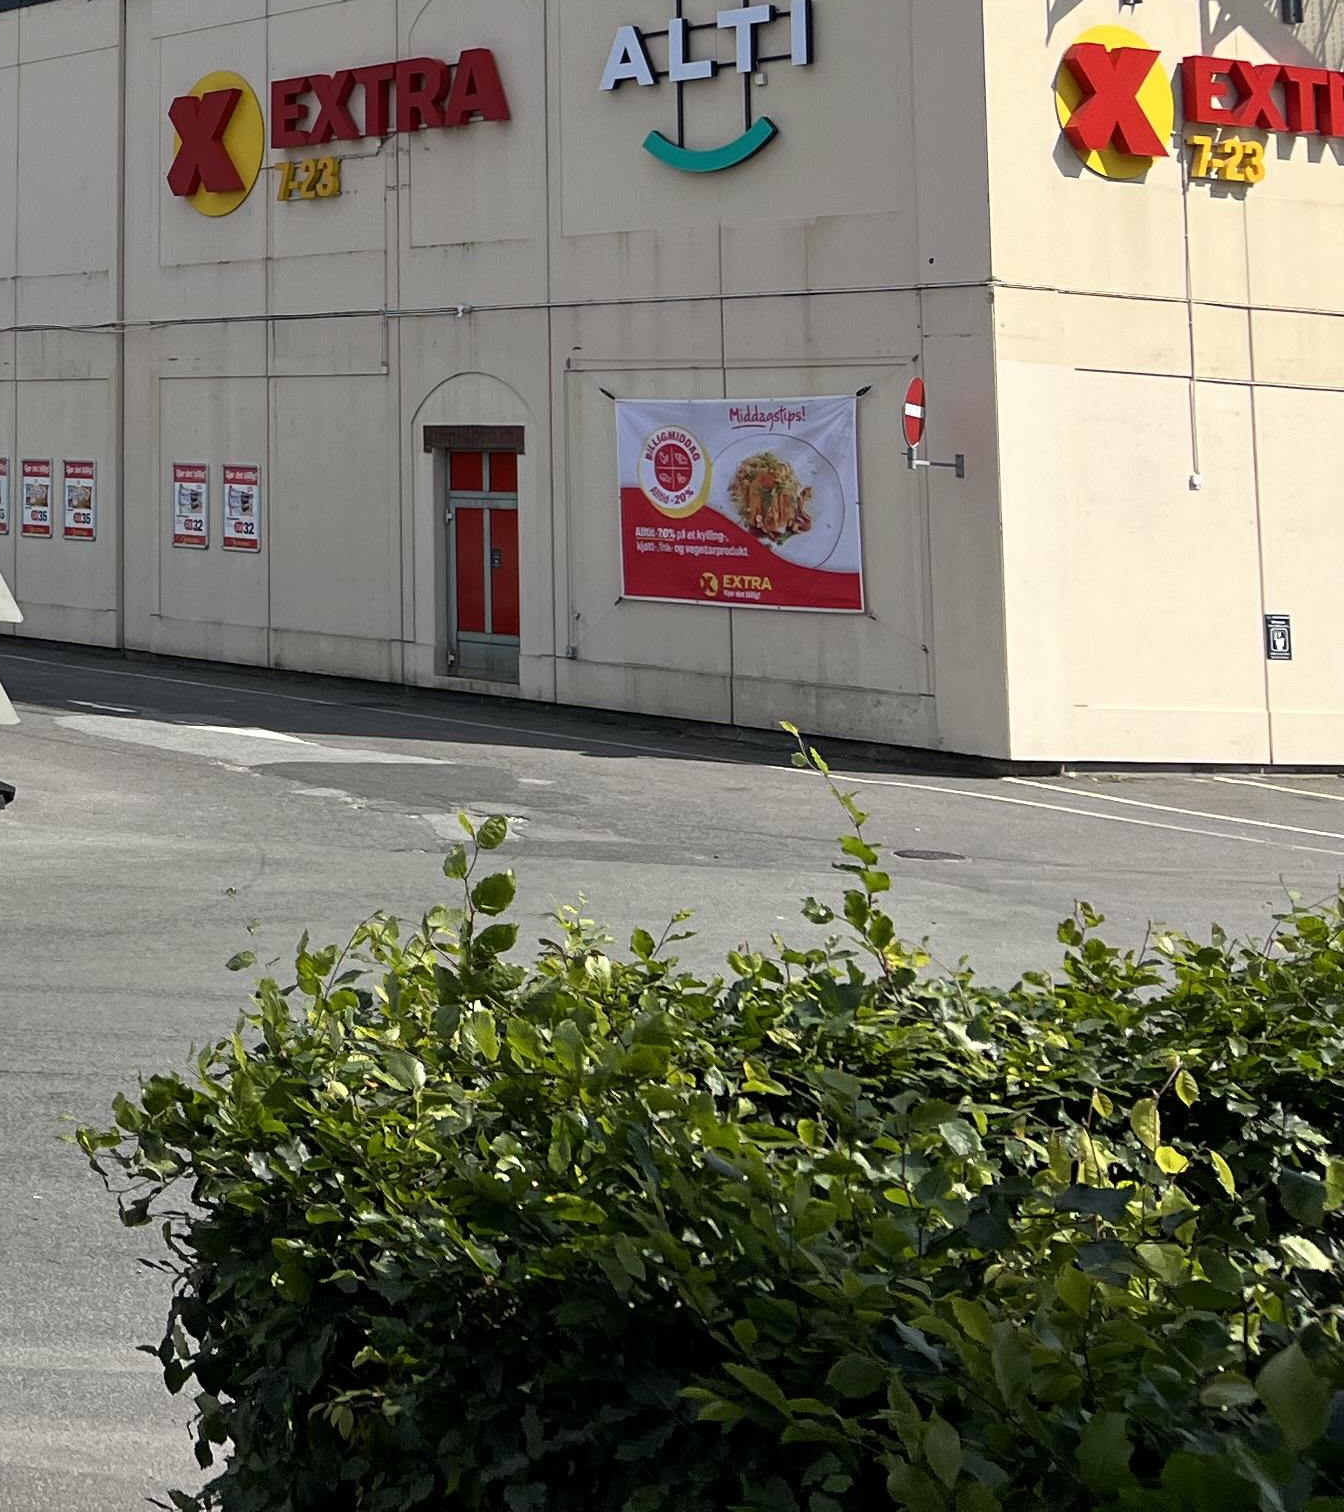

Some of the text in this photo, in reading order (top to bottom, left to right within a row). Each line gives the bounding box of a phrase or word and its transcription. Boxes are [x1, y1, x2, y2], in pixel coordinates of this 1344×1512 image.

[271, 48, 510, 149] EXTRA
[1183, 55, 1344, 139] EXT
[1188, 136, 1266, 184] 7-23
[275, 156, 342, 201] 7-23
[729, 405, 806, 431] Middagstips!
[645, 431, 700, 461] BILLIGMIDDAG
[38, 511, 47, 522] 35
[81, 513, 91, 524] 35
[193, 520, 203, 531] 32
[243, 522, 254, 534] 32
[723, 575, 772, 590] EXTRA
